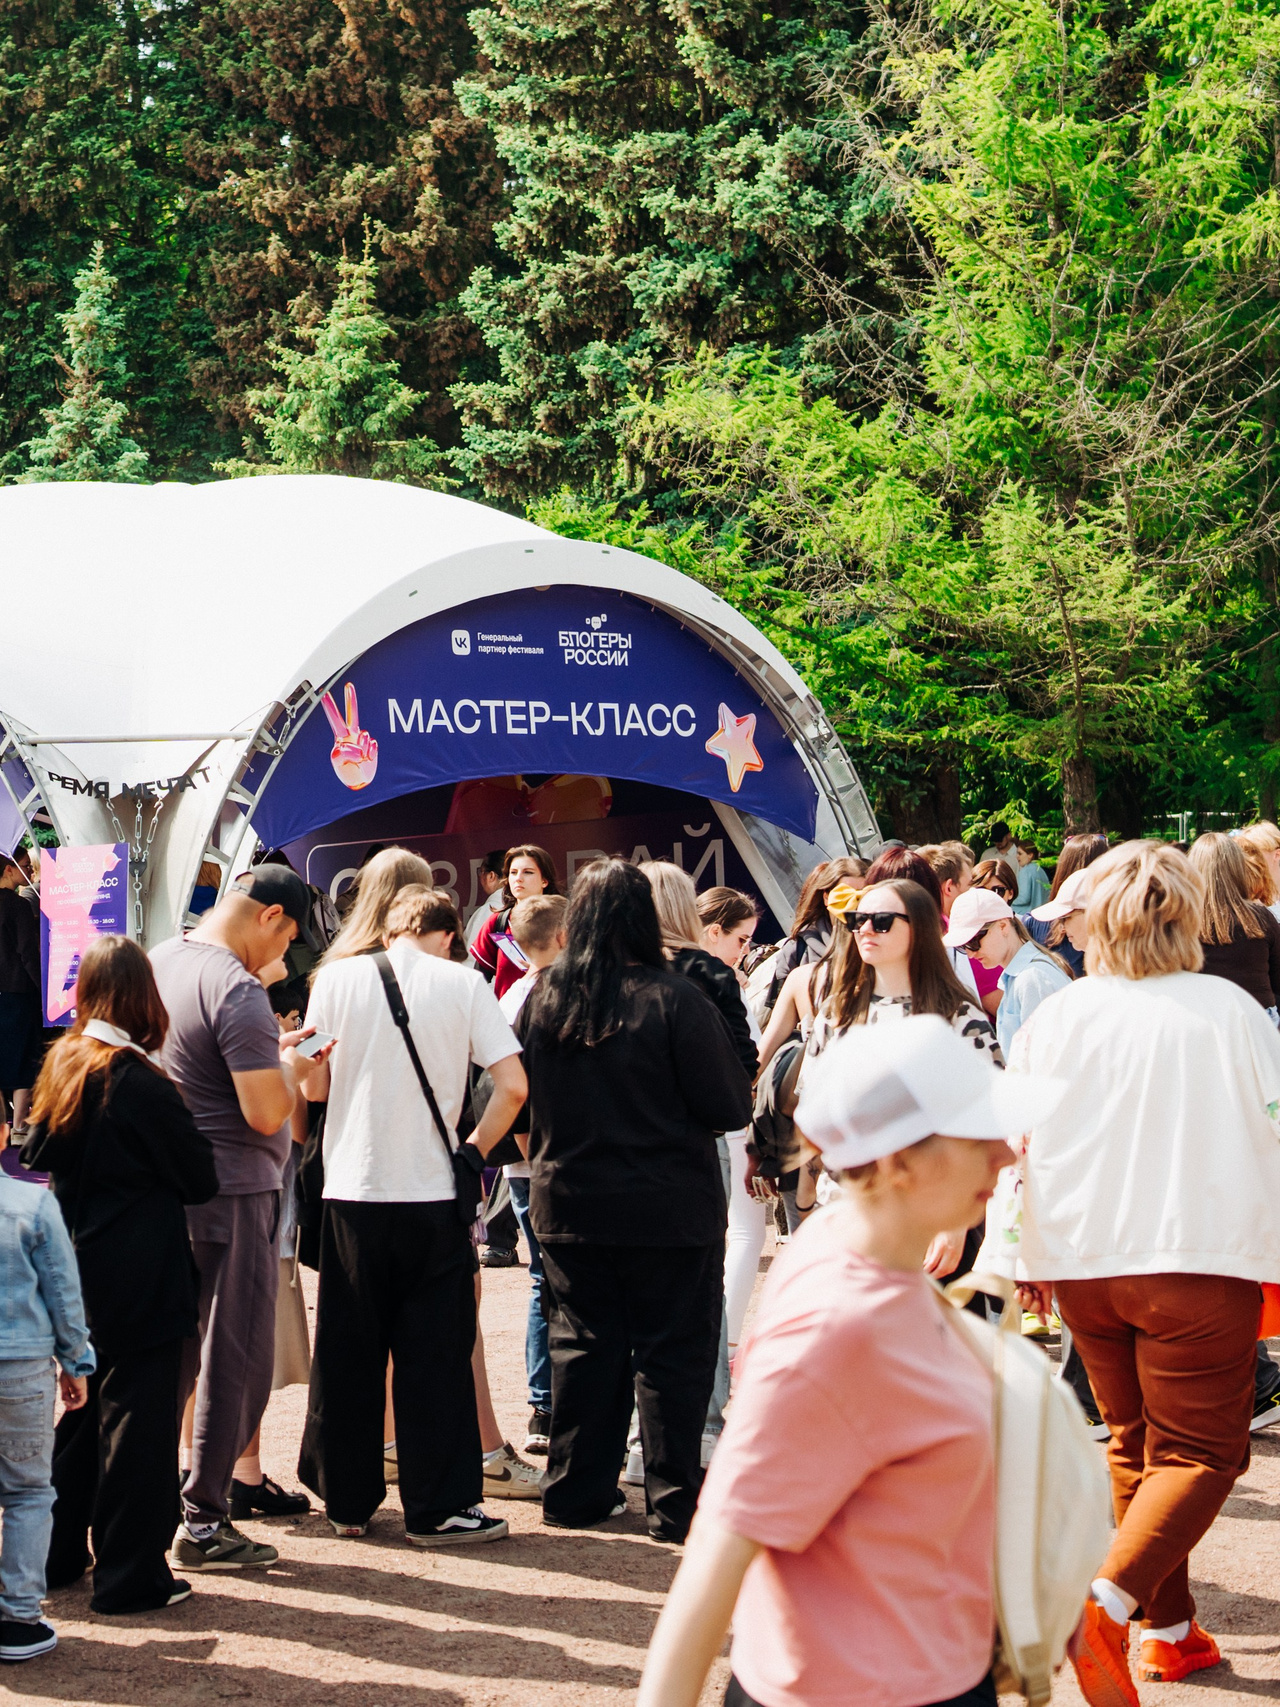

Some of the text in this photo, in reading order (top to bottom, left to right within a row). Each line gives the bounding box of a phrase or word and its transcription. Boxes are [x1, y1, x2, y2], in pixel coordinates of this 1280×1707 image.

[477, 632, 523, 643] Генеральный
[558, 630, 632, 649] БЛОГЕРЫ
[478, 645, 544, 655] партнер фестиваля
[564, 649, 629, 667] РОССИИ
[387, 698, 696, 737] МАСТЕР-КЛАСС
